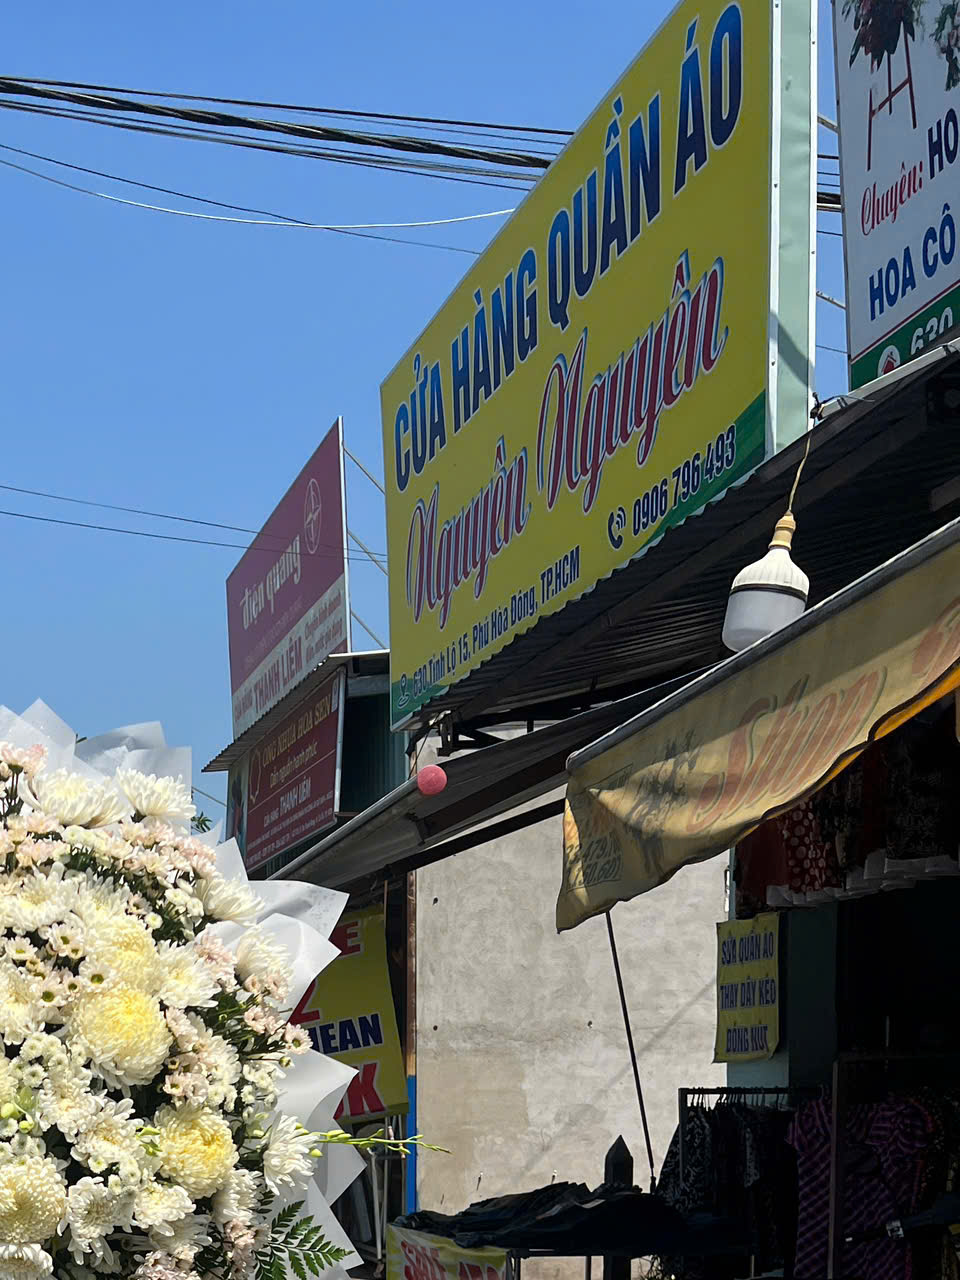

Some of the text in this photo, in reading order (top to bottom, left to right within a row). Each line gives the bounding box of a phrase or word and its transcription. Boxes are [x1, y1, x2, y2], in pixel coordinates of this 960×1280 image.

[861, 160, 923, 236] Chuyên:
[394, 2, 744, 492] CỬA HÀNG QUẦN ÁO
[869, 202, 956, 321] HOA CÔ
[632, 423, 737, 537] 0906 796 493
[266, 534, 302, 615] quang
[540, 545, 580, 605] TP.HCM
[254, 660, 281, 713] THANH
[720, 983, 739, 1010] THAY
